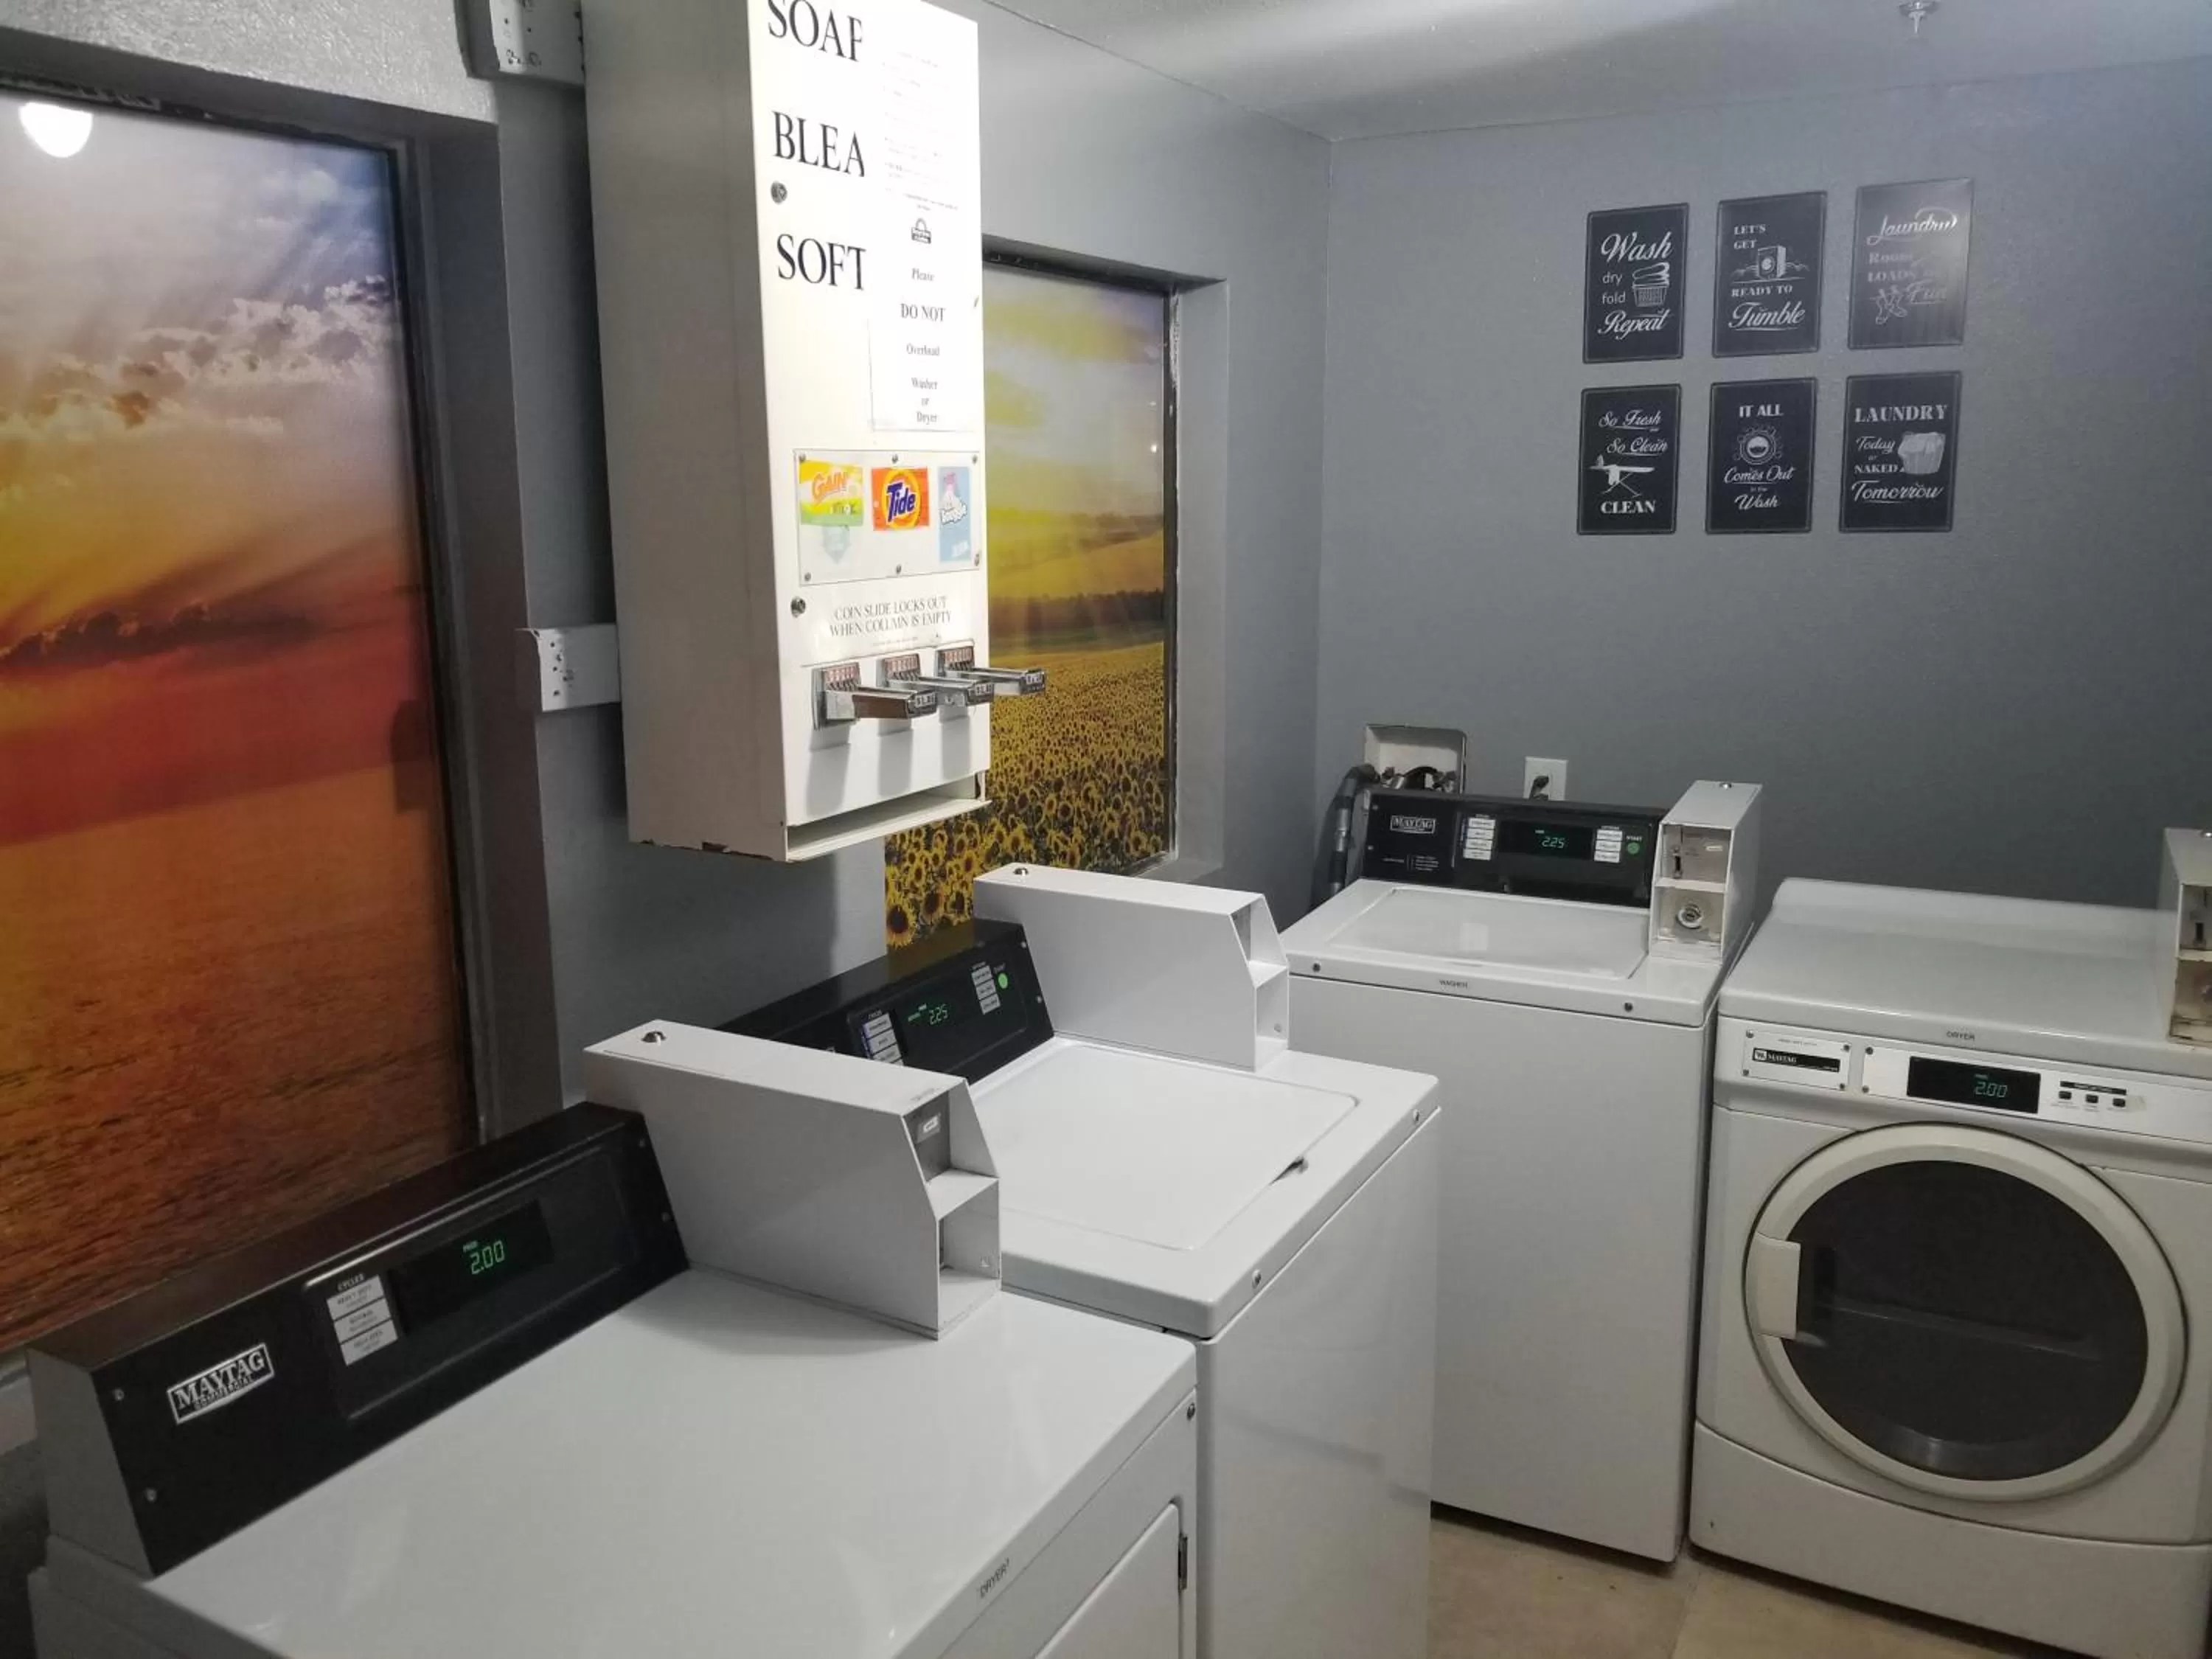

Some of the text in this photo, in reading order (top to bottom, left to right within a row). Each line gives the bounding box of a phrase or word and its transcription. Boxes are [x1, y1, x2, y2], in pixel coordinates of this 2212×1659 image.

[1734, 224, 1766, 235] LET'S
[1601, 232, 1672, 262] Wash
[1733, 240, 1757, 250] GET
[776, 234, 866, 291] SOFT
[1602, 271, 1622, 286] dry
[1602, 292, 1626, 304] fold
[1731, 285, 1792, 297] READY TO
[900, 303, 945, 321] DO NOT
[1728, 301, 1805, 328] Tumble
[1598, 308, 1670, 340] Repeat
[1599, 409, 1661, 428] So Fresh
[1739, 404, 1784, 417] IT ALL
[1854, 404, 1947, 422] LAUNDRY
[1607, 436, 1668, 453] So Clean
[1855, 437, 1896, 454] Today
[1724, 465, 1796, 484] Comes Out
[1854, 464, 1898, 473] NAKED
[1851, 481, 1944, 501] Tomorrow
[887, 481, 917, 522] Tide
[1601, 501, 1656, 514] CLEAN
[1734, 494, 1779, 510] Wash
[834, 595, 947, 621] COIN SLIDE LOCKS OUT
[830, 620, 862, 636] WHEN
[912, 615, 919, 626] IS
[922, 611, 951, 625] EMPTY
[470, 1240, 505, 1275] 2.00
[174, 1352, 265, 1410] MAYTAG
